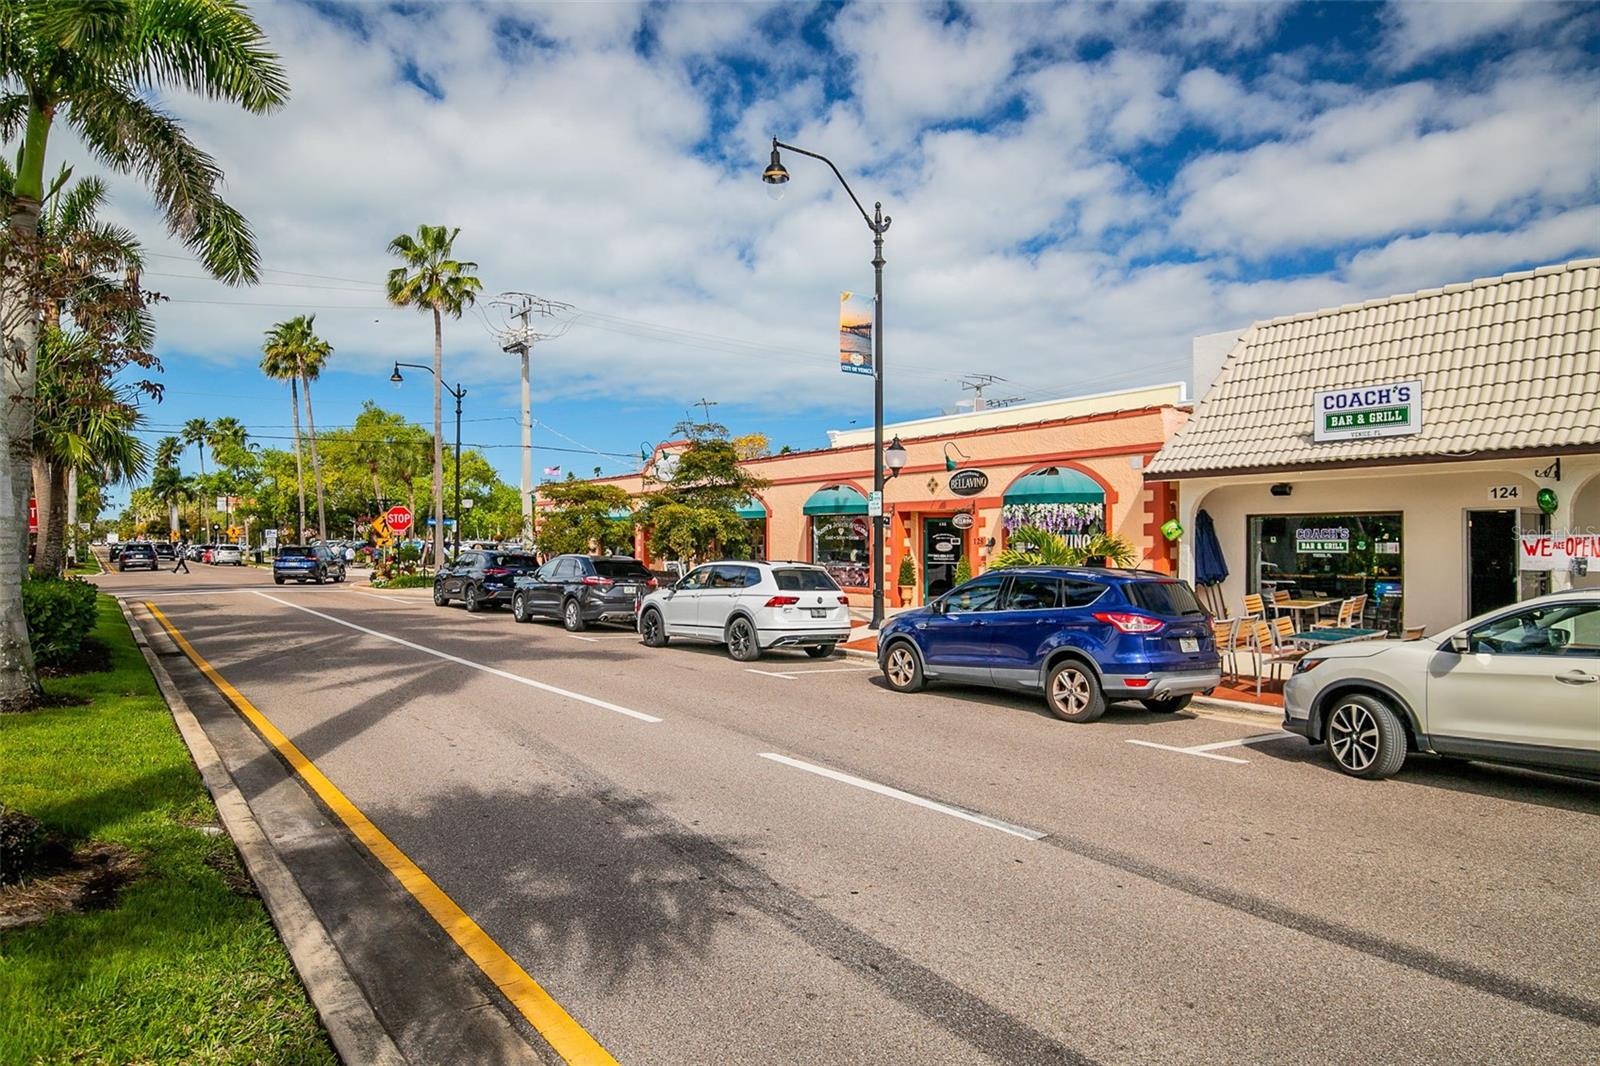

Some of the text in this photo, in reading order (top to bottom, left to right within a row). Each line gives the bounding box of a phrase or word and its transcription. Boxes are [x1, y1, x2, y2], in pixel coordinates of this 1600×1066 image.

[1324, 385, 1410, 410] COACH'S
[1331, 410, 1402, 427] BAR & GRILL
[950, 477, 987, 490] BELLAVINO
[1490, 486, 1519, 499] 124
[388, 513, 411, 523] STOP
[1296, 526, 1350, 540] COACH'S
[1301, 542, 1345, 550] BAR & GRILL
[1522, 537, 1600, 557] WE ARE OPEN
